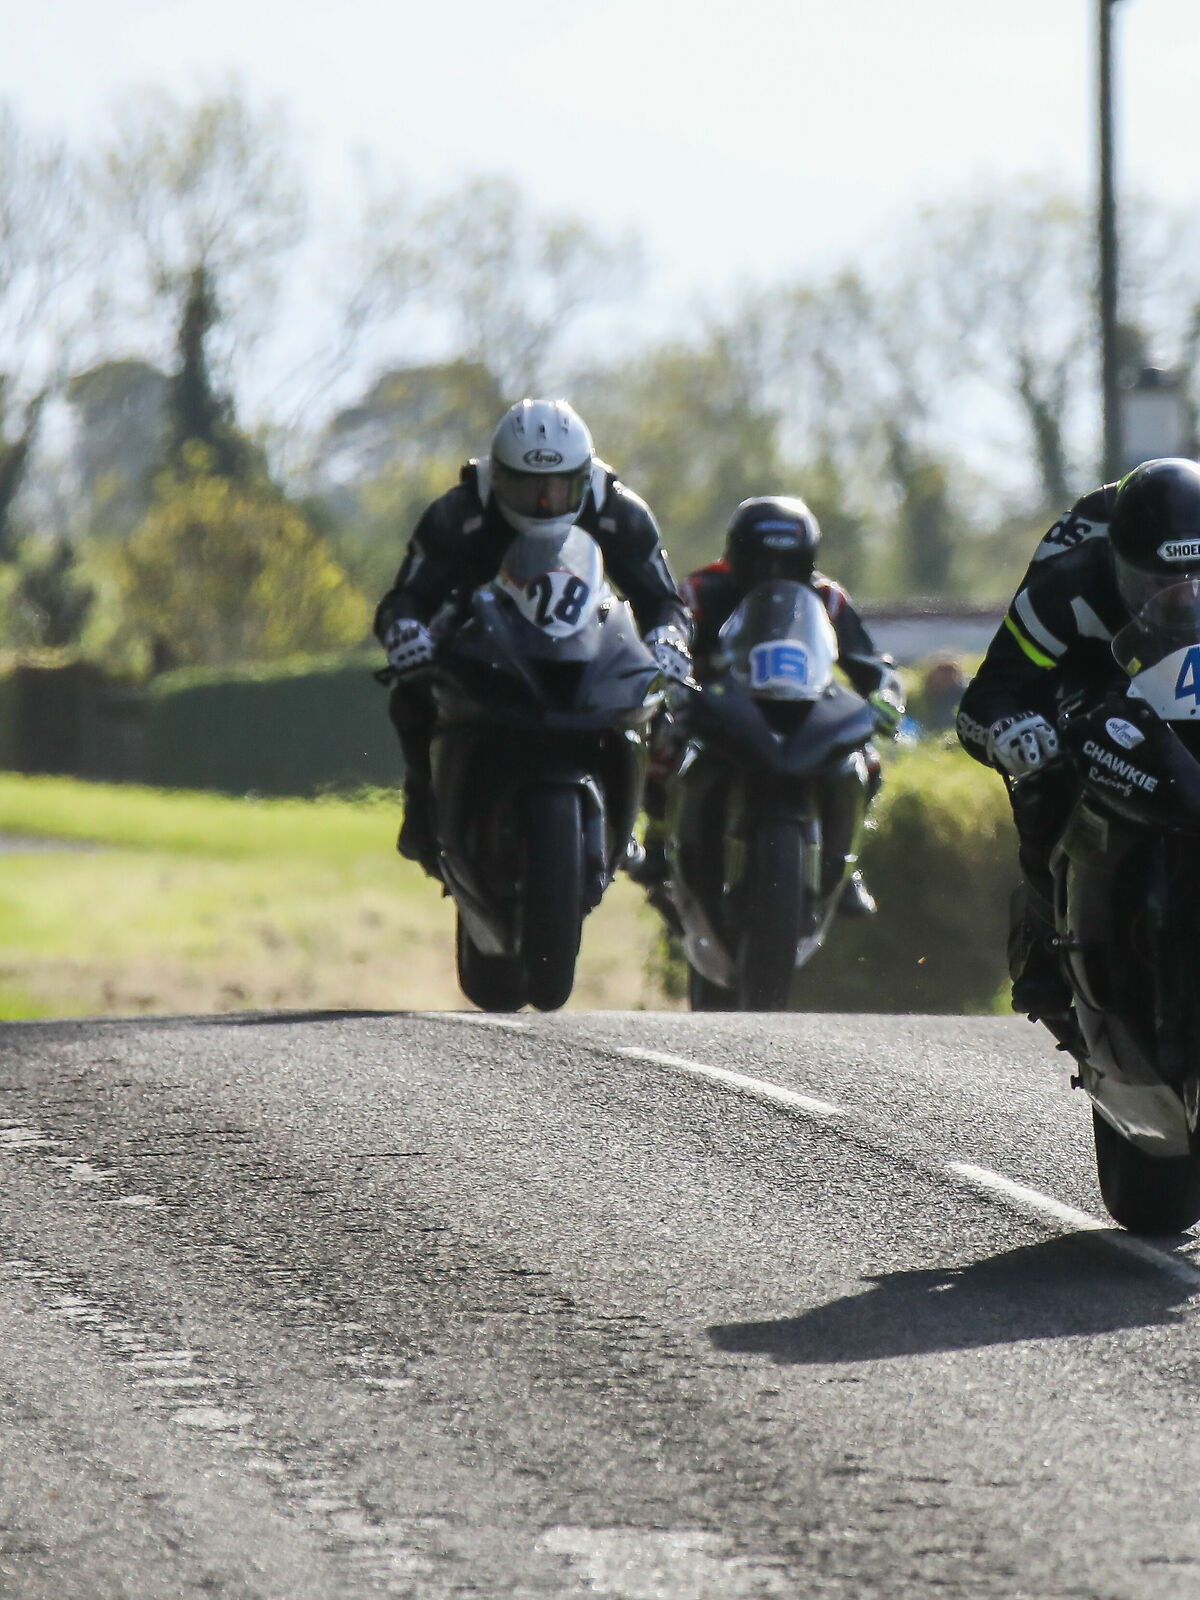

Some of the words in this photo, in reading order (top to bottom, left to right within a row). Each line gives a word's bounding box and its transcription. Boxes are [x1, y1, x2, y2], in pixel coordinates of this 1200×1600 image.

[526, 573, 590, 626] 28
[756, 646, 807, 684] 16
[1083, 740, 1158, 792] CHAWKIE
